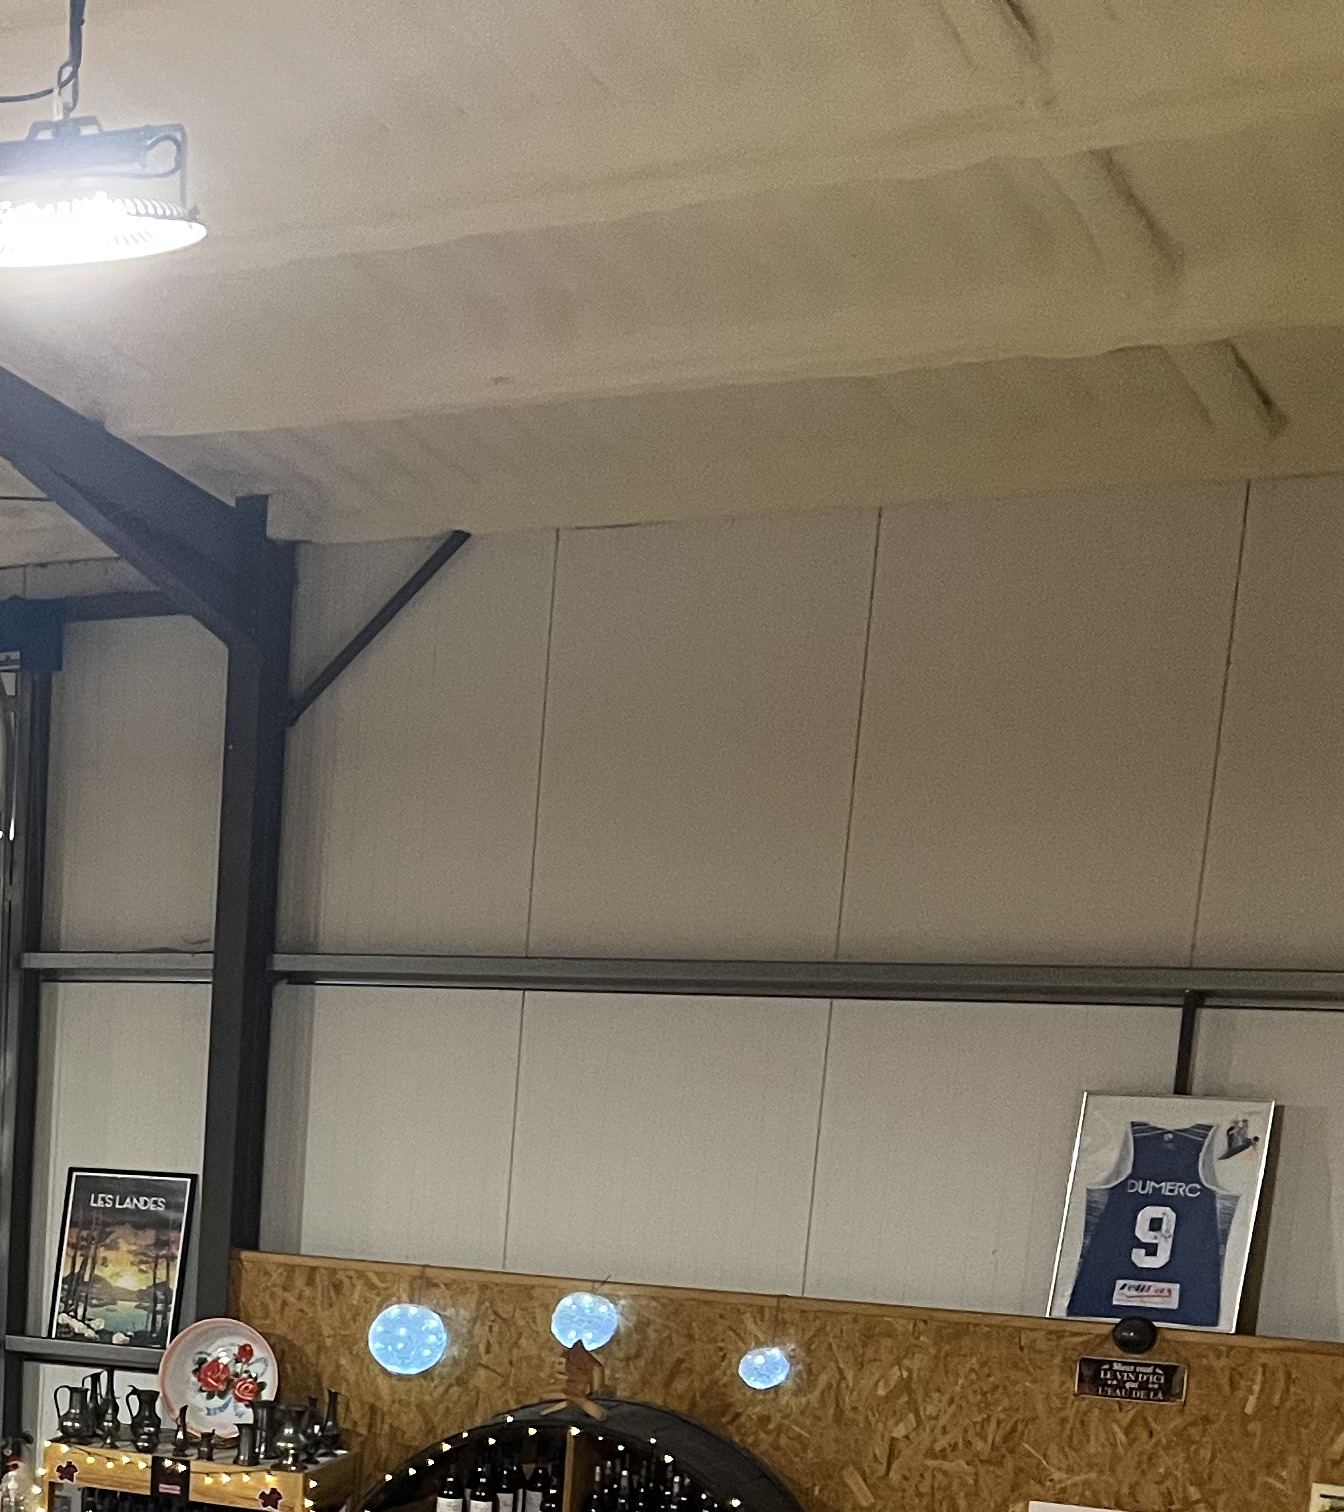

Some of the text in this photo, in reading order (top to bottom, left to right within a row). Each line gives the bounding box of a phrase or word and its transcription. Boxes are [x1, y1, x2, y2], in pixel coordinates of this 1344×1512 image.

[1127, 1179, 1202, 1198] DUMERC
[90, 1193, 167, 1211] LES LANDES
[1130, 1205, 1177, 1269] 9
[1100, 1370, 1165, 1384] LE VIN D'ICI
[1098, 1386, 1130, 1398] L'EAU
[1132, 1390, 1148, 1399] DE
